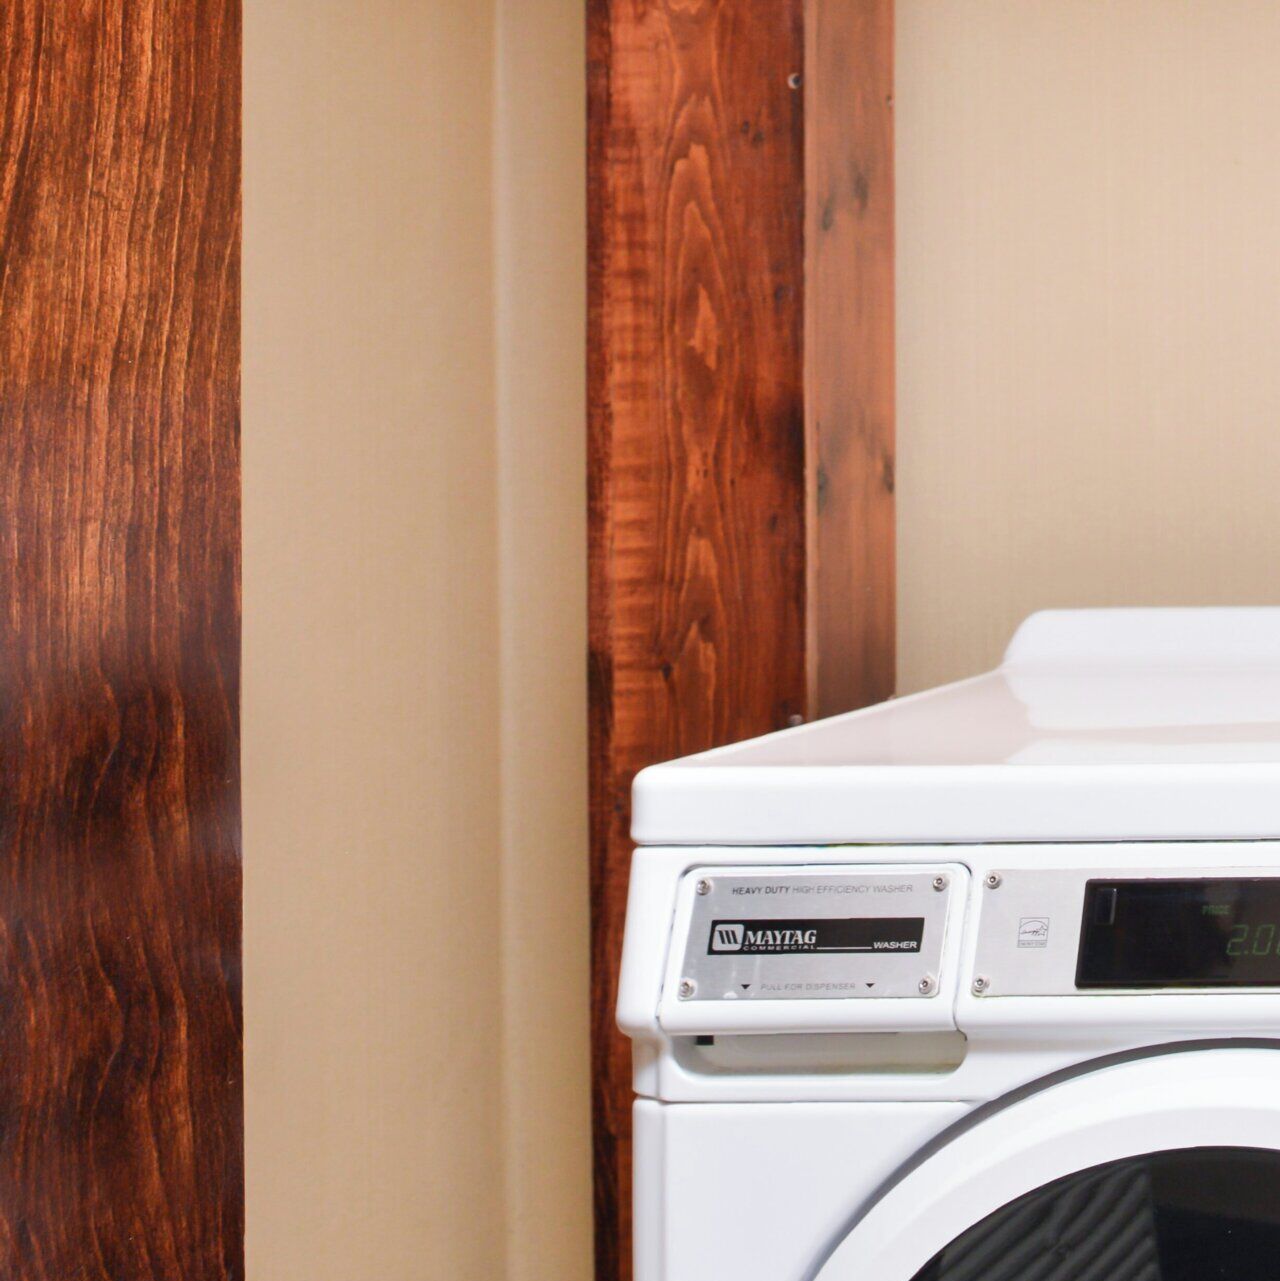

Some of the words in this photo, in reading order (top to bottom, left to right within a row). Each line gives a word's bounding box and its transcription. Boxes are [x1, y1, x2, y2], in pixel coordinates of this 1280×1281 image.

[732, 886, 763, 896] HEAVY
[765, 886, 790, 894] DUTY
[792, 885, 813, 894] HIGH
[816, 885, 870, 894] EFFICIENCY
[873, 884, 913, 893] WASHER
[744, 929, 817, 945] MAYTAG
[873, 941, 918, 950] WASHER
[760, 983, 781, 991] PULL
[784, 983, 802, 991] FOR
[805, 982, 856, 991] DISPENSER
